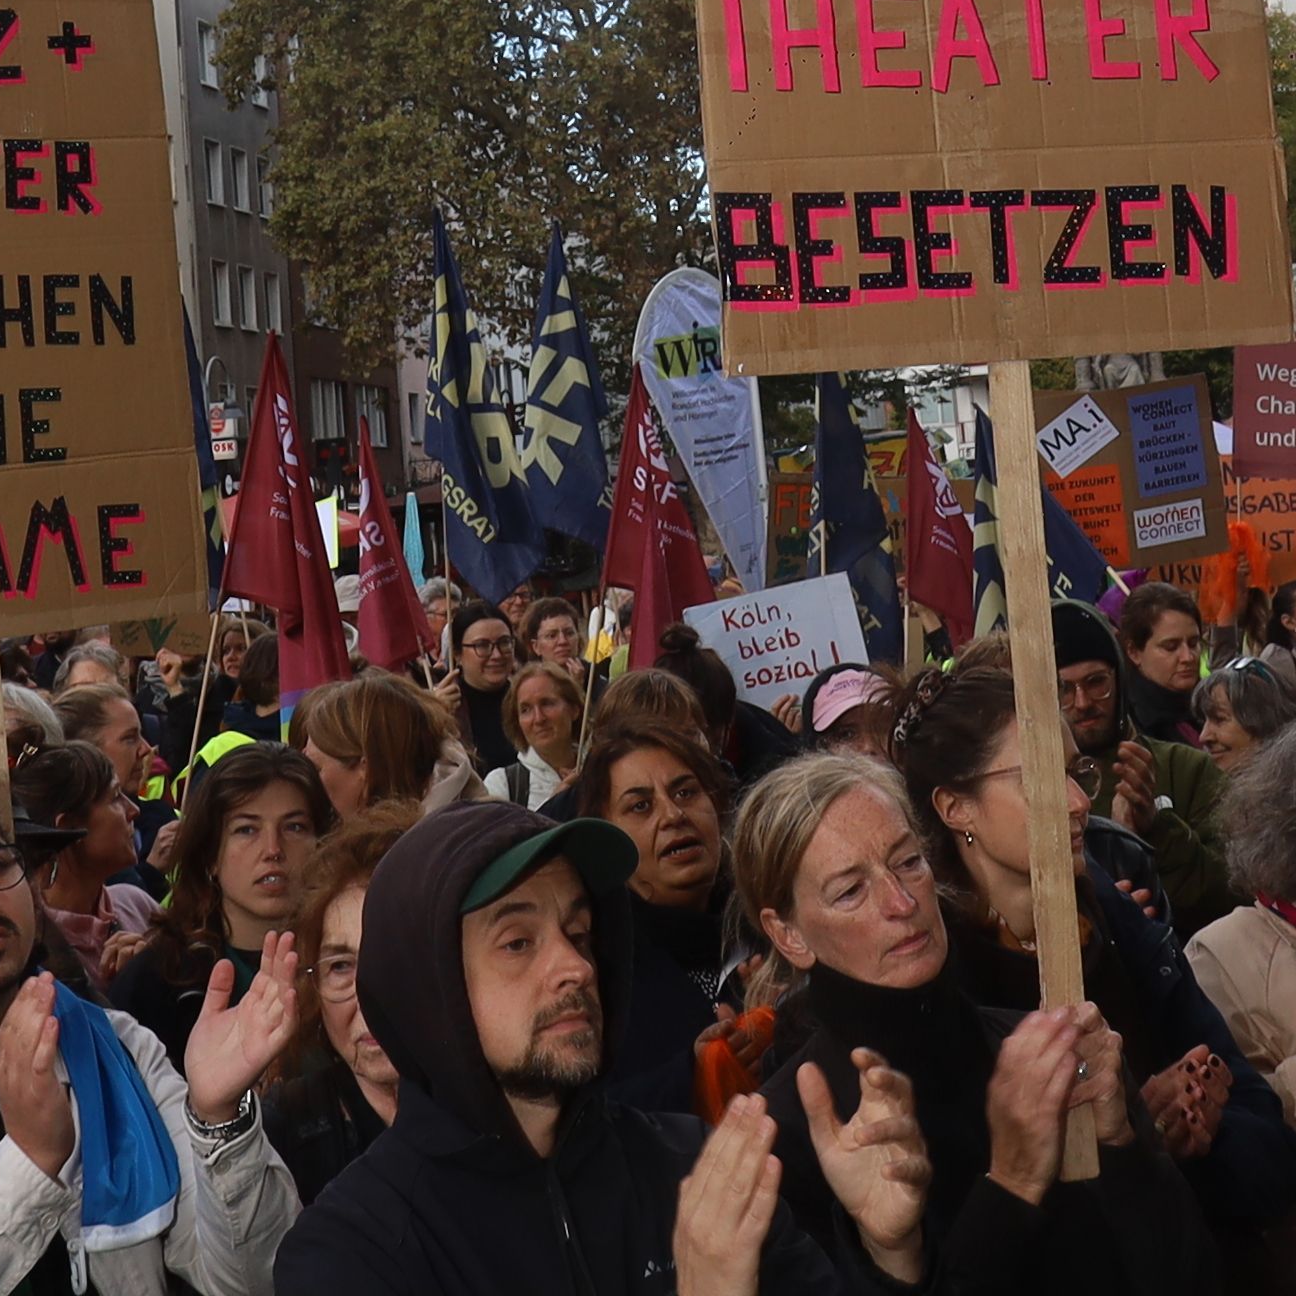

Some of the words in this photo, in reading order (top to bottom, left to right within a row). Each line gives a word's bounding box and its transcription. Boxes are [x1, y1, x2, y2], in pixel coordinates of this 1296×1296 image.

[714, 184, 1239, 313] BESETZEN
[1131, 398, 1173, 414] WOMEN
[1142, 403, 1193, 422] CONNECT
[1152, 420, 1177, 433] BAUT
[1255, 429, 1296, 447] und
[1138, 444, 1199, 464] KÜRZUNGEN
[1154, 461, 1186, 475] BAUEN
[1068, 475, 1116, 490] ZUKUNFT
[1144, 473, 1200, 491] BARRIEREN
[1074, 492, 1096, 503] DER
[1139, 519, 1201, 542] CONNECT
[738, 627, 801, 660] bleib
